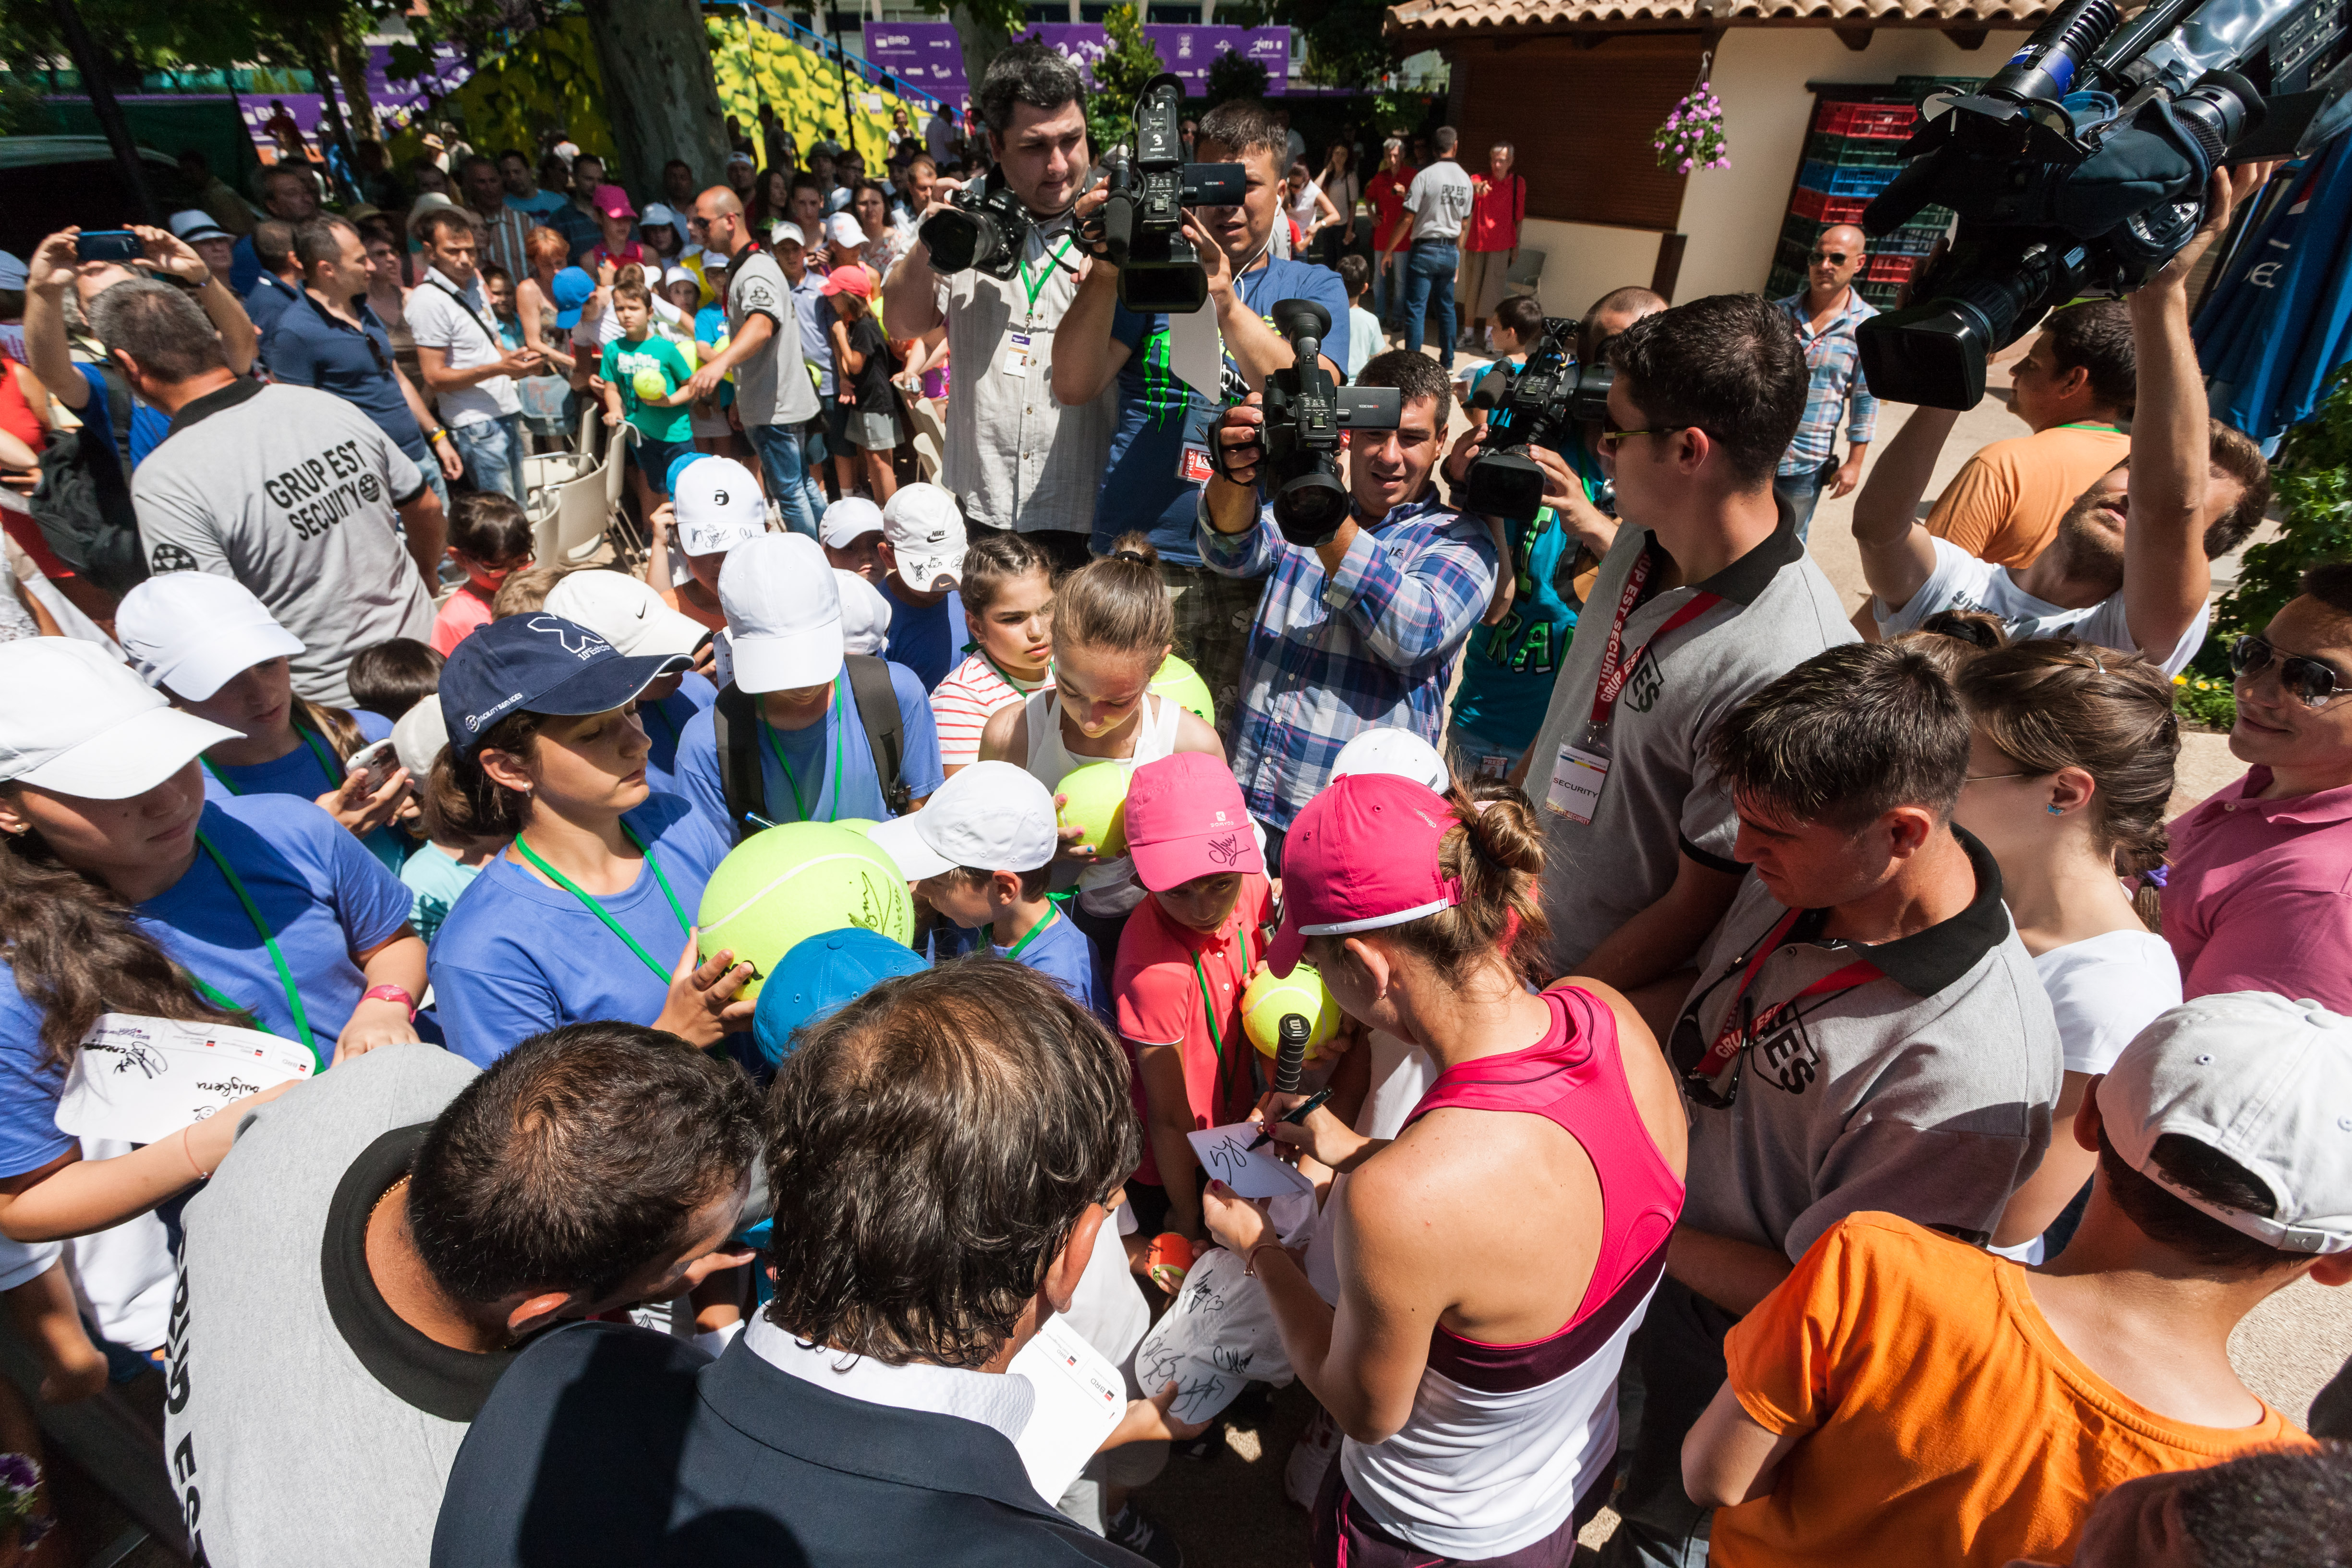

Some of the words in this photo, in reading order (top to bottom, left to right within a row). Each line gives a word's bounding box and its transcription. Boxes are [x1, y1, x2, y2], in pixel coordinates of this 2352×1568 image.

[1152, 134, 1163, 146] 3
[988, 198, 1006, 210] Nikon
[264, 458, 329, 509] GRUP
[322, 439, 367, 480] EST
[1185, 450, 1196, 477] PRESS
[288, 481, 362, 541] SECURITY
[1618, 583, 1638, 617] EST
[1600, 619, 1622, 685] SECURI
[1600, 671, 1621, 703] GRUP
[1624, 645, 1643, 673] EST
[478, 705, 498, 723] FACILITY
[497, 693, 523, 710] SERVICES
[1588, 760, 1606, 768] ROMANIA
[1553, 777, 1599, 798] SECURITY
[1546, 802, 1558, 812] GRUP
[1567, 811, 1590, 826] SECURITY
[1715, 1030, 1743, 1058] GRU
[282, 1058, 298, 1068] BRD
[1057, 1349, 1067, 1360] BRD
[1091, 1378, 1106, 1393] BRD
